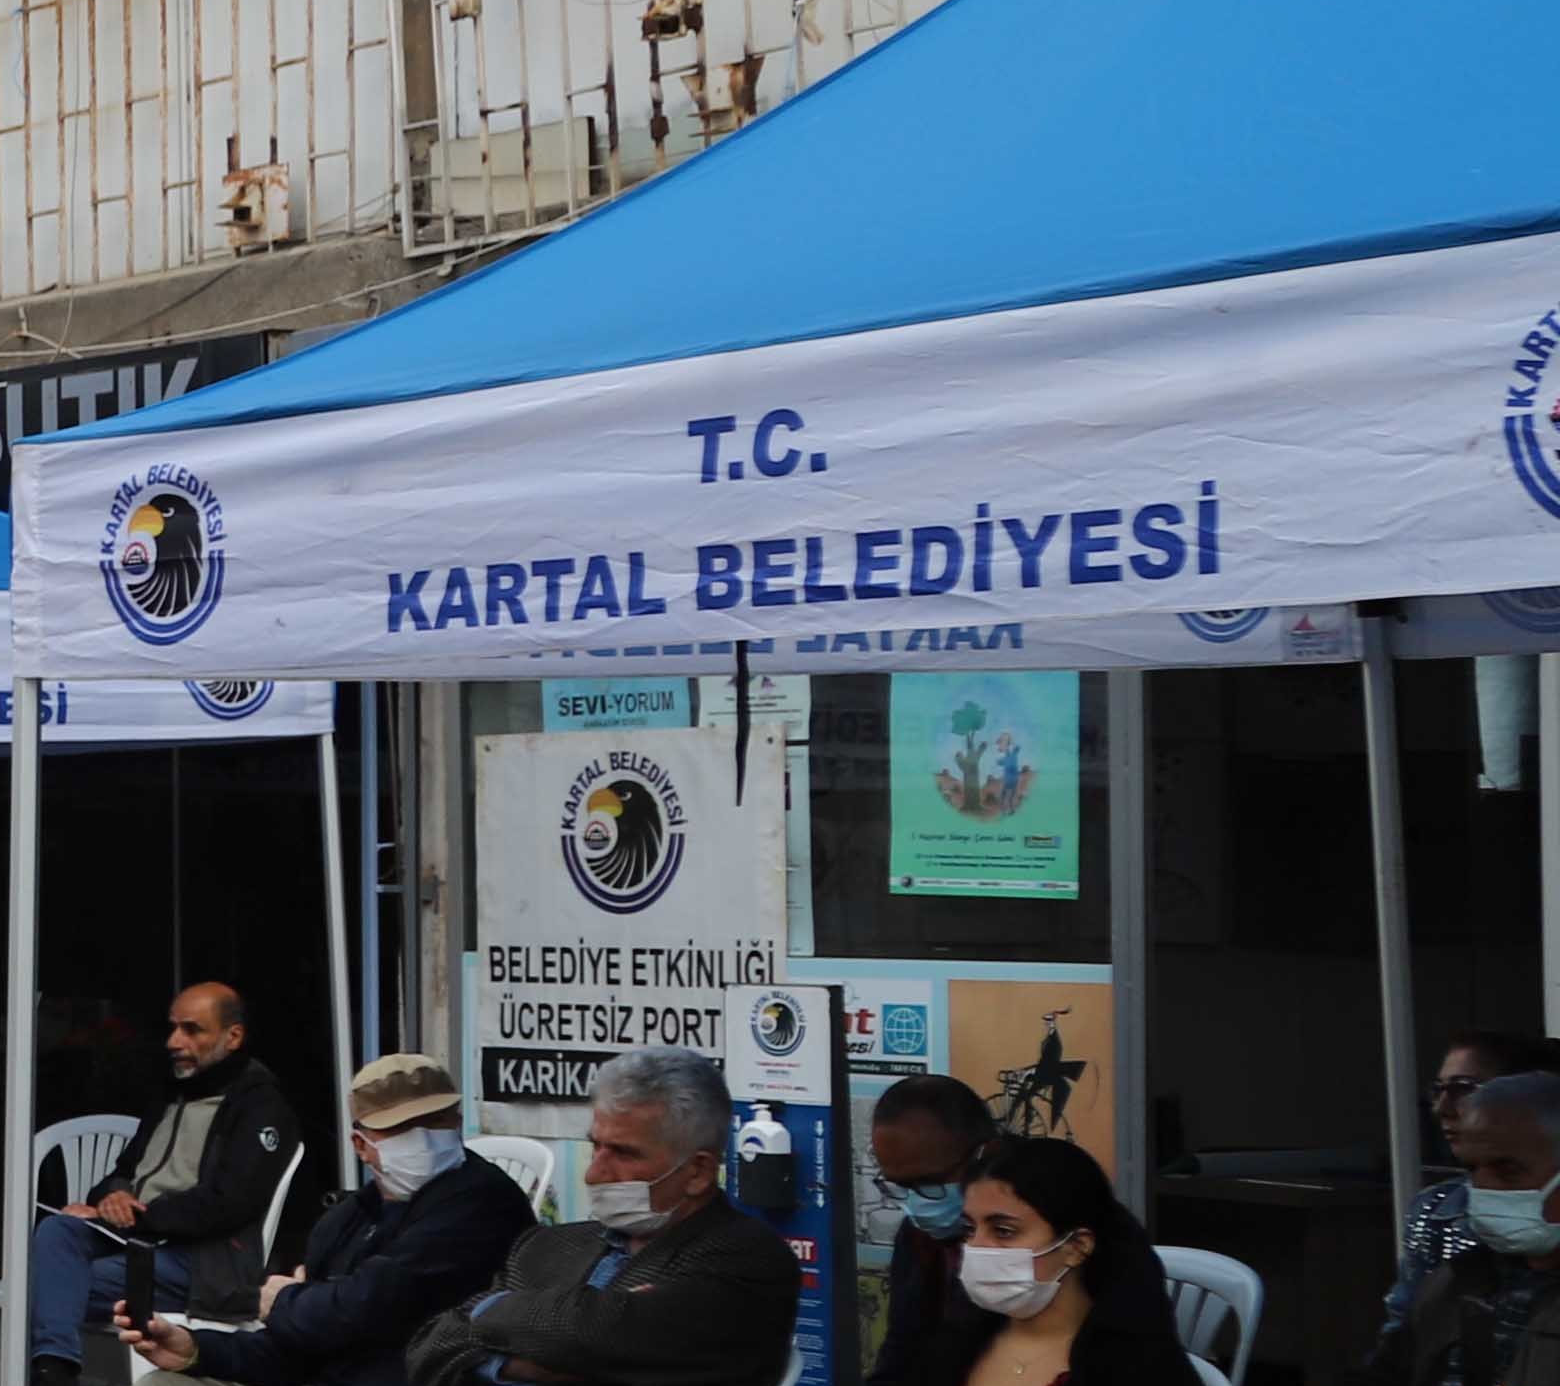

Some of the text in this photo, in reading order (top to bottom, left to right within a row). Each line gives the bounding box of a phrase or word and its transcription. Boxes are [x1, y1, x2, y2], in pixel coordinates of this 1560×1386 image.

[1504, 300, 1560, 407] KART
[688, 408, 828, 483] T.C.
[101, 463, 228, 555] KARTAL BELEDİYESİ
[385, 480, 1220, 633] KARTAL BELEDİYESİ
[561, 751, 688, 830] KARTAL BELEDİYESİ
[489, 938, 774, 989] BELEDİYE ETKİNLİĞİ
[499, 994, 634, 1044] ÜCRETSİZ
